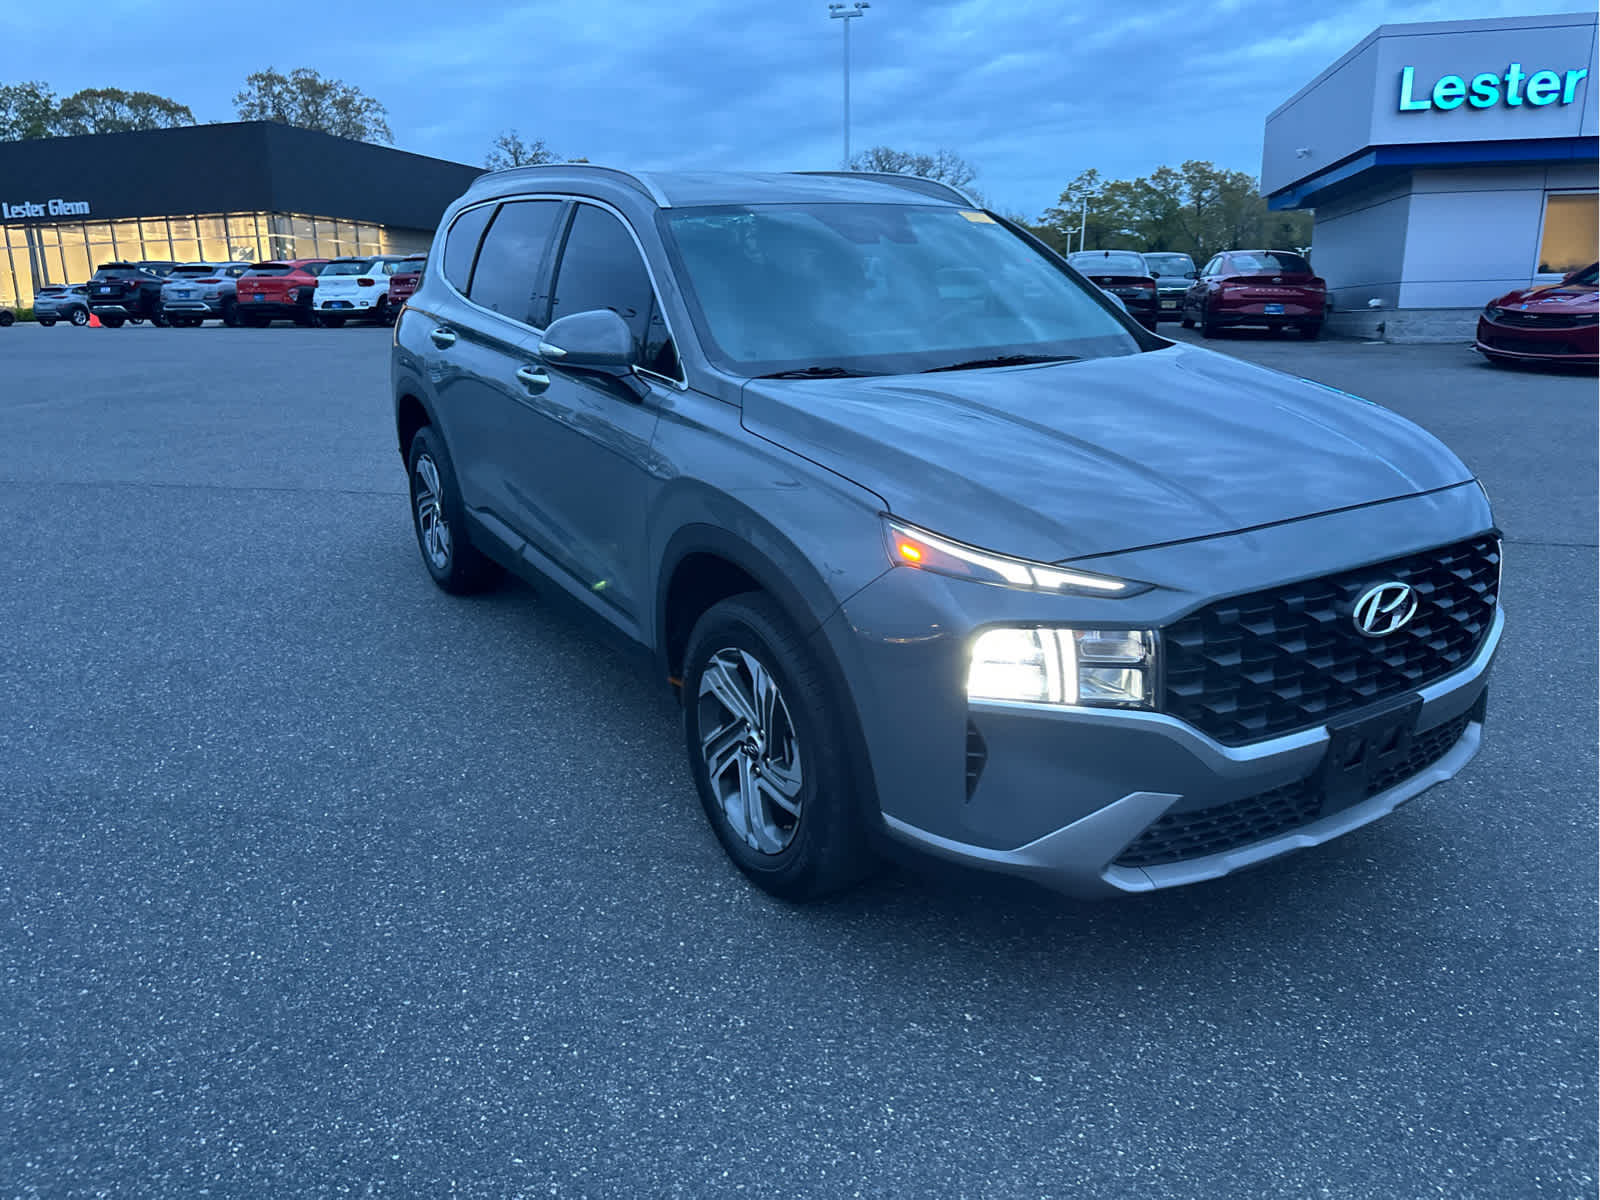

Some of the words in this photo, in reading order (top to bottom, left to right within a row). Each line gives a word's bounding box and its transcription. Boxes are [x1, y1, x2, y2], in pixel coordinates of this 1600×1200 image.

[1400, 62, 1588, 111] Lester
[2, 201, 46, 219] Lester
[48, 199, 90, 216] Glenn
